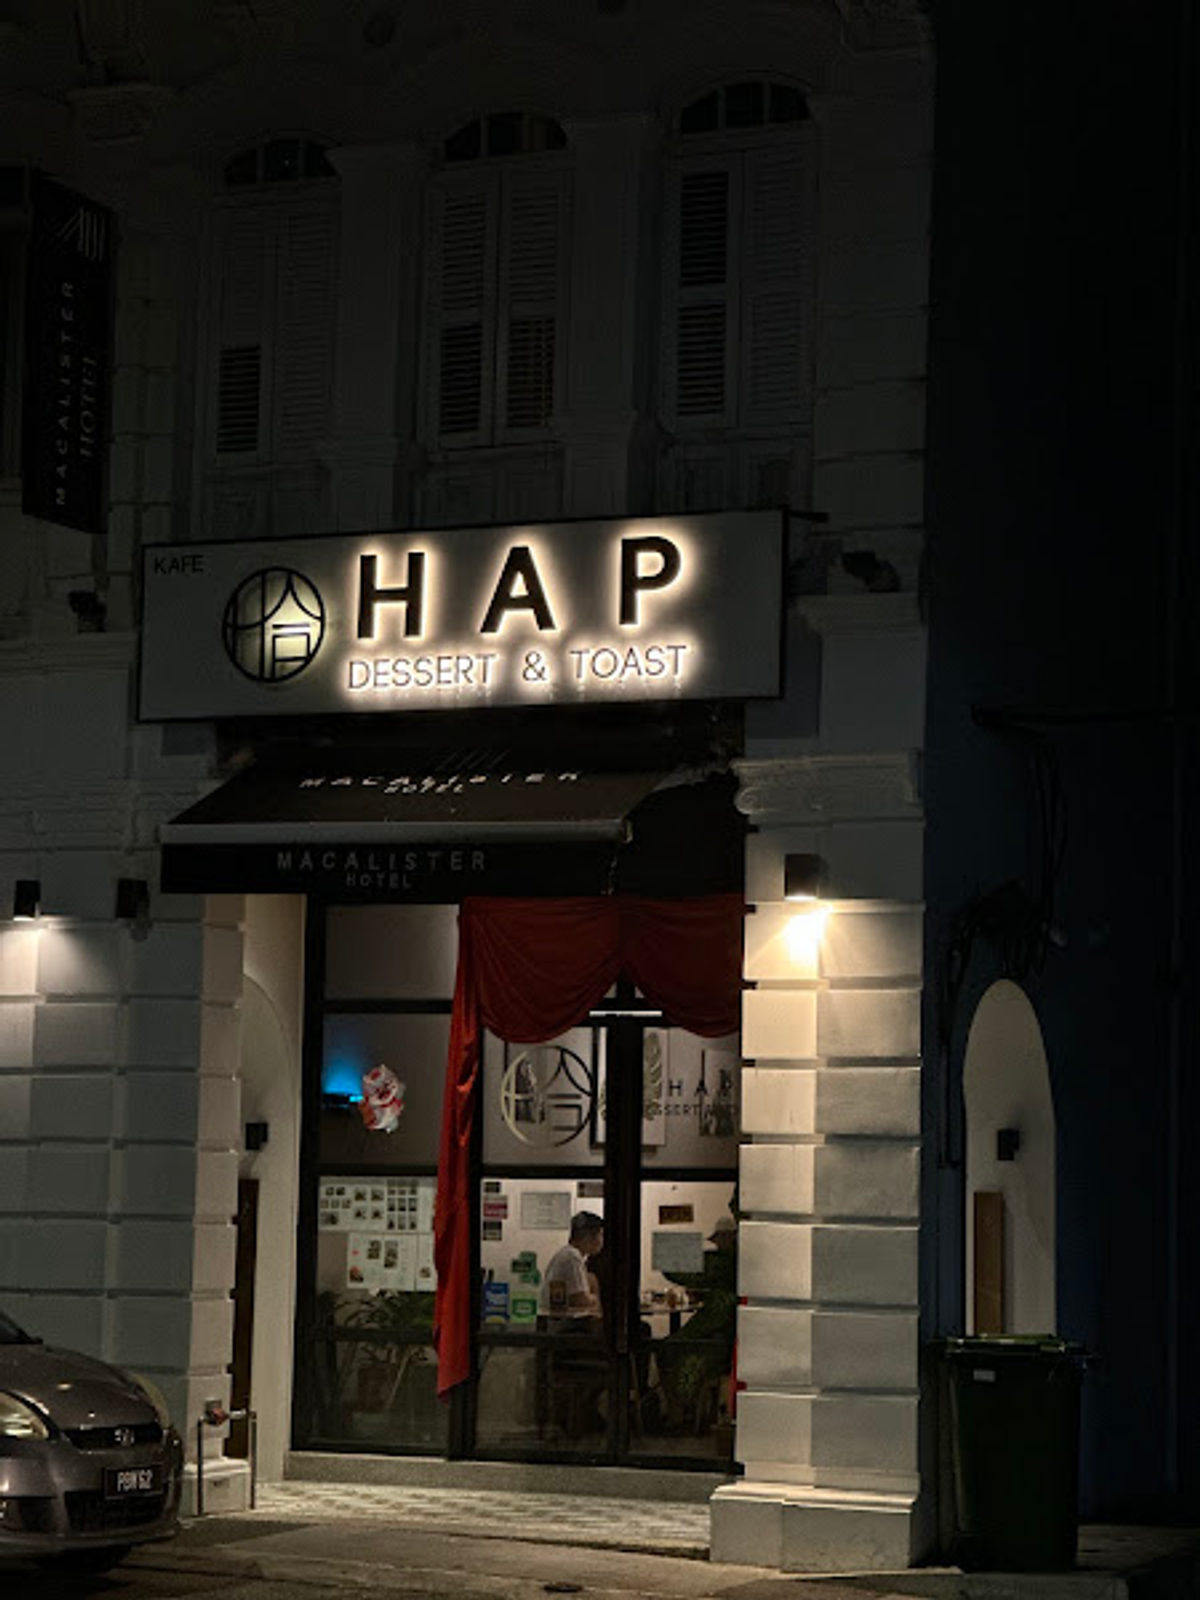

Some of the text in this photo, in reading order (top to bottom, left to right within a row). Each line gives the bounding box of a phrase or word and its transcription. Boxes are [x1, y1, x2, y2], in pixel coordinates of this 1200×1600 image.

[56, 280, 74, 506] MACALISTER
[80, 356, 97, 458] HOTEL
[155, 555, 204, 575] KAFE
[358, 536, 682, 638] HAP
[349, 645, 688, 691] DESSERT & TOAST
[277, 850, 486, 871] MACALISTER
[346, 872, 413, 889] HOTEL
